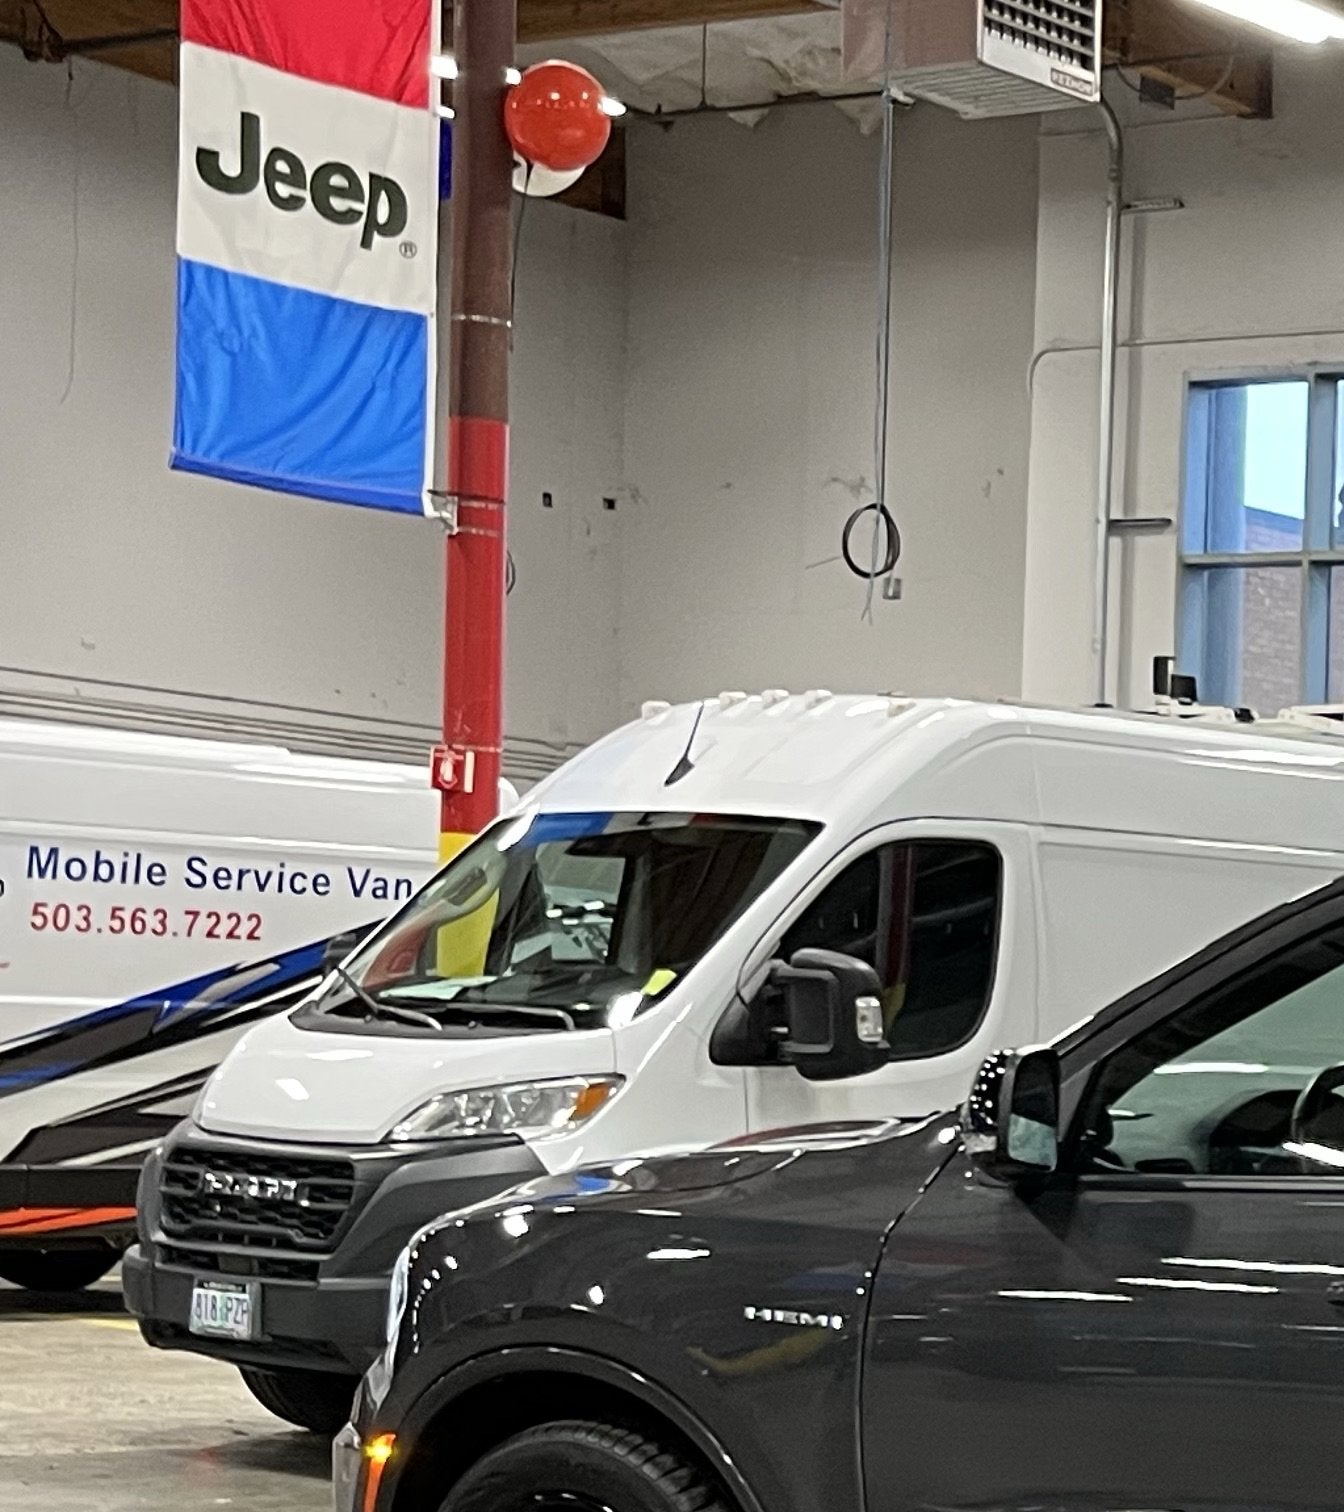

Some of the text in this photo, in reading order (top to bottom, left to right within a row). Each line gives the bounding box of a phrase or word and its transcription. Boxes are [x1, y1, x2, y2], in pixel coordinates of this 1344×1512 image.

[195, 111, 408, 251] Jeep
[26, 845, 413, 900] Mobile Service Van
[30, 902, 263, 941] 503.563.7222
